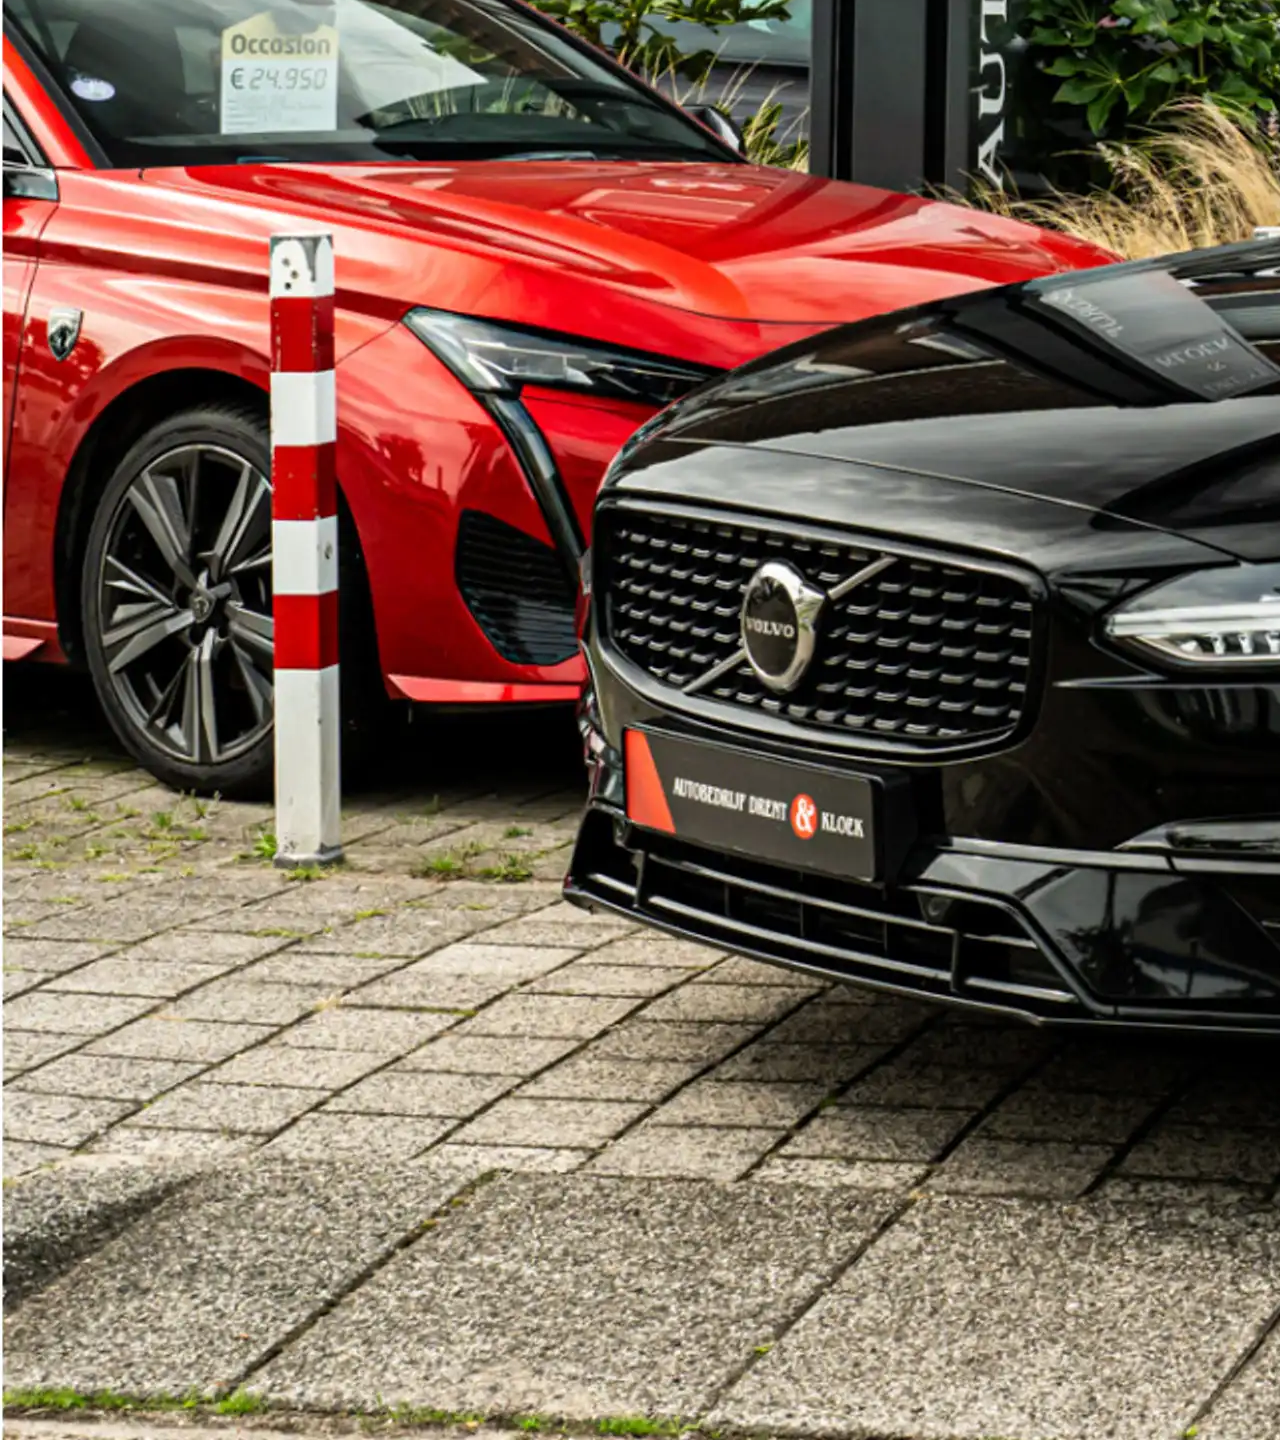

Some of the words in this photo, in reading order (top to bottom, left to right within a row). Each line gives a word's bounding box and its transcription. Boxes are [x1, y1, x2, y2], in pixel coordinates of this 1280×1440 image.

[230, 33, 331, 55] Occasion
[746, 616, 796, 638] VOLVO
[673, 777, 746, 811] AUTOBEDRIJF
[748, 795, 788, 822] DRENT
[796, 798, 815, 833] &
[821, 812, 865, 838] KLOEK
